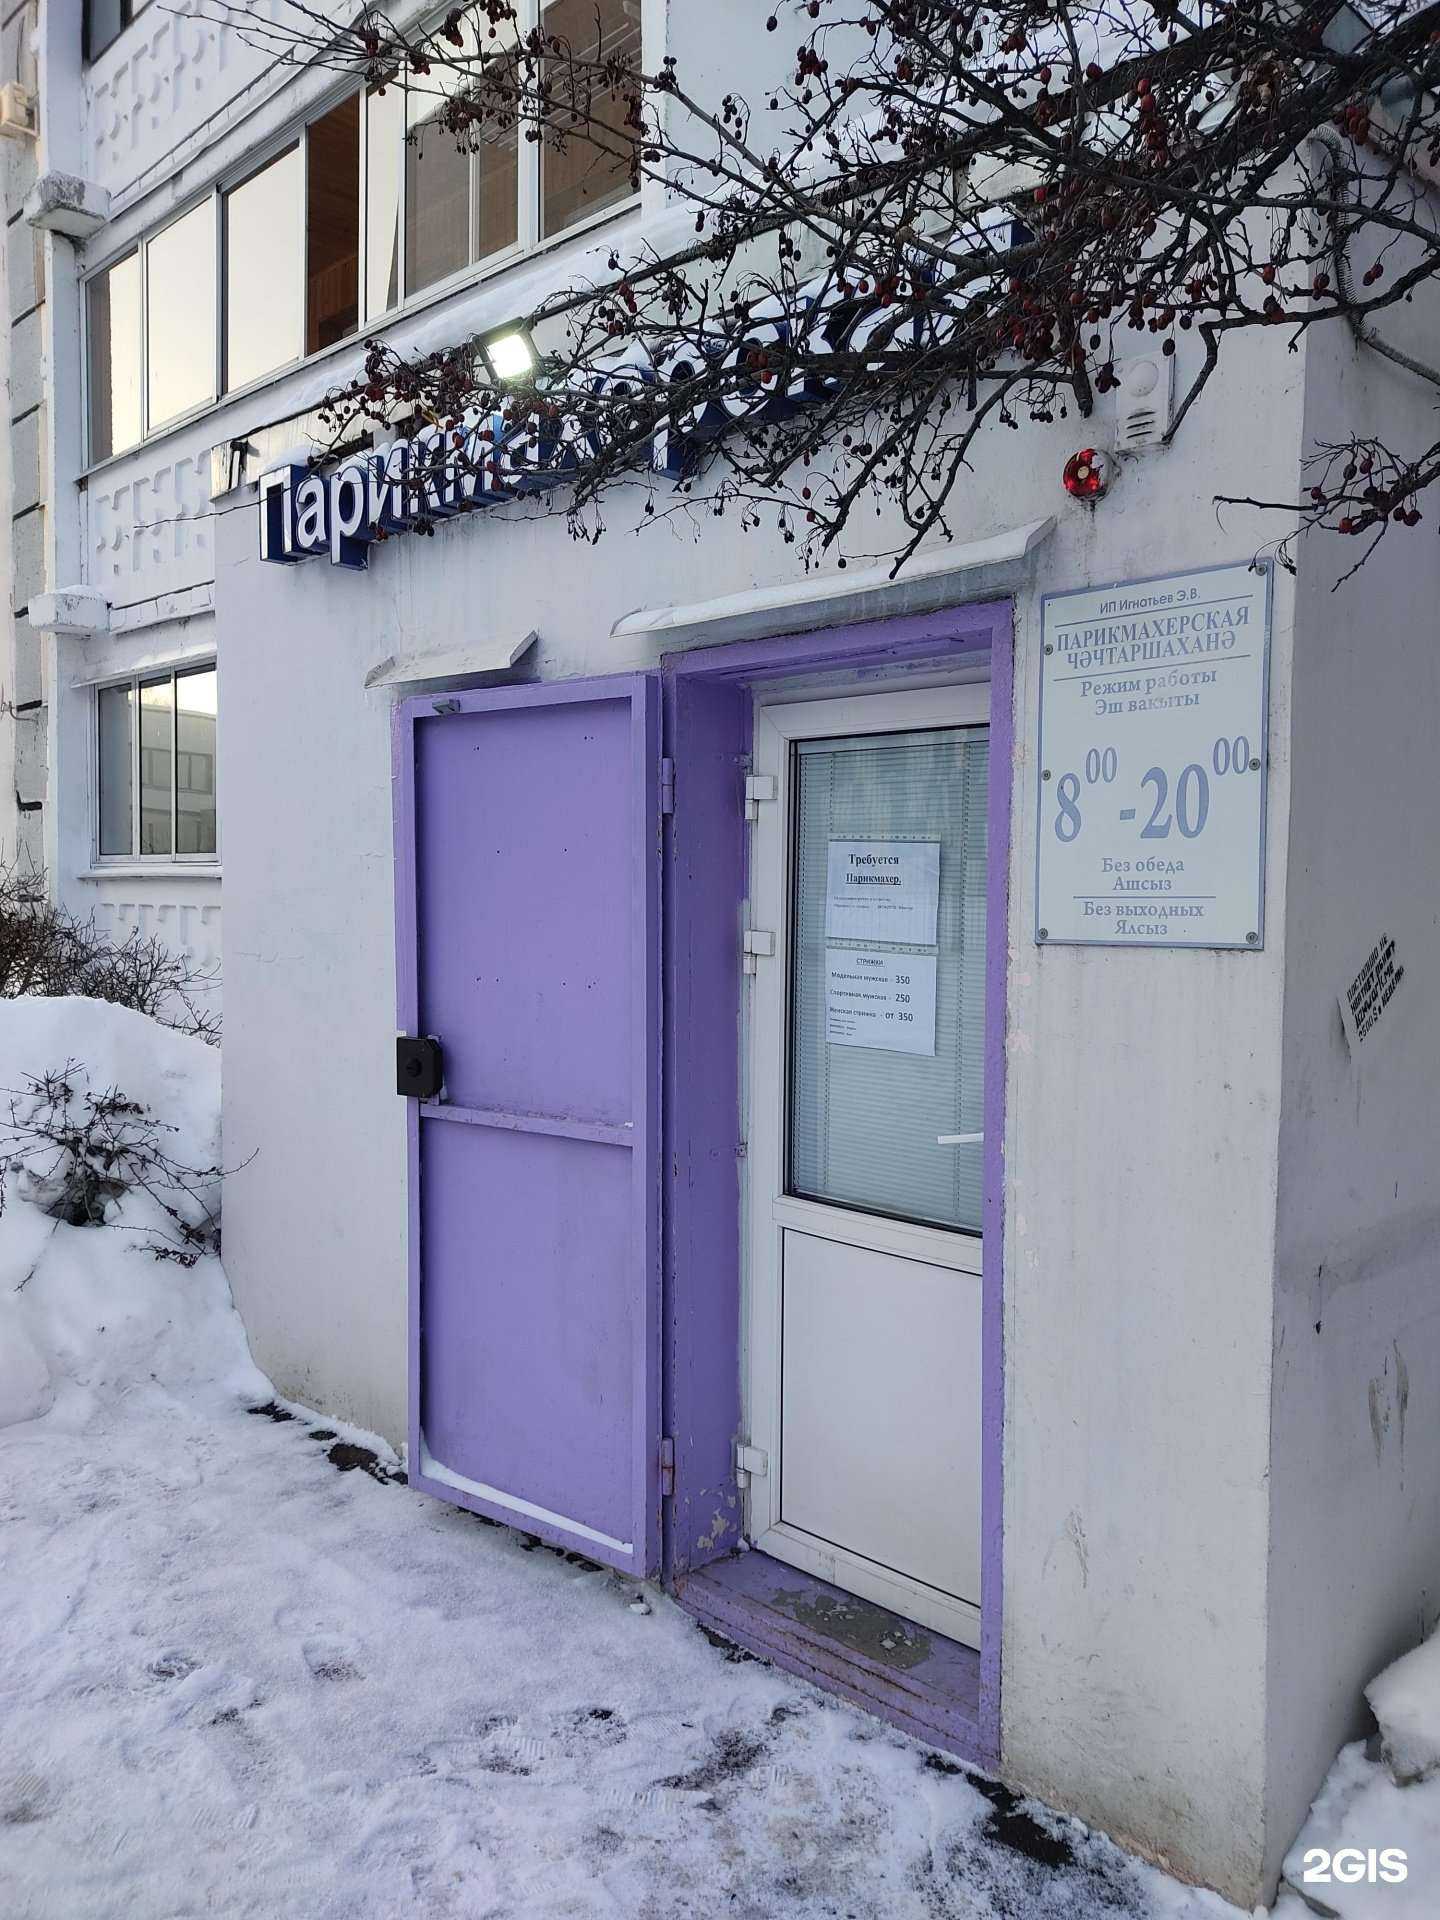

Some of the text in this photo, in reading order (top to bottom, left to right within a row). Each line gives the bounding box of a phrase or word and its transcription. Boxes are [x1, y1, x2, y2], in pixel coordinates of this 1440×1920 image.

[1100, 588, 1201, 615] ИП Игнатьев Э.В.
[1057, 606, 1249, 651] ПАРИКМАХЕРСКАЯ
[1067, 630, 1236, 669] ЧӘЧТАРШАХАНӘ
[1080, 669, 1217, 697] Режим работы
[1095, 693, 1200, 716] Эш вакыты
[848, 853, 899, 867] Требуется
[1101, 856, 1185, 875] Без обеда
[1112, 876, 1172, 891] Ашсыз
[1083, 901, 1204, 919] Без выходных
[1114, 919, 1168, 935] Ялсыз
[895, 975, 911, 985] 350
[895, 993, 911, 1003] 250
[898, 1012, 914, 1022] 350
